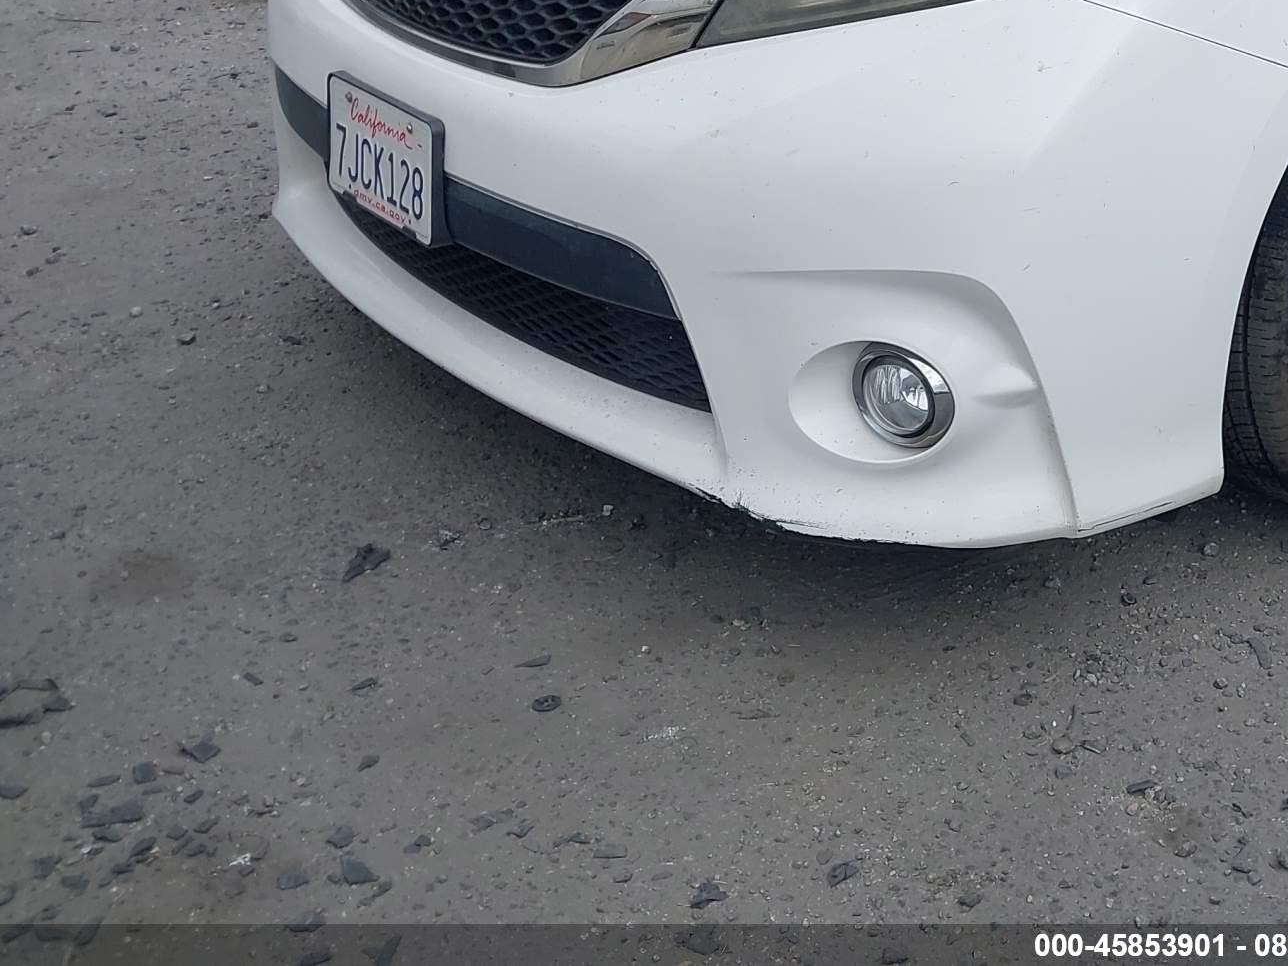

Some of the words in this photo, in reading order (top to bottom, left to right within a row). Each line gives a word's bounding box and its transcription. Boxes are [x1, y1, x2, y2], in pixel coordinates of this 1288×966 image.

[350, 97, 413, 150] California
[335, 122, 424, 221] 7JCK128
[353, 188, 406, 223] dmv.ca.gov
